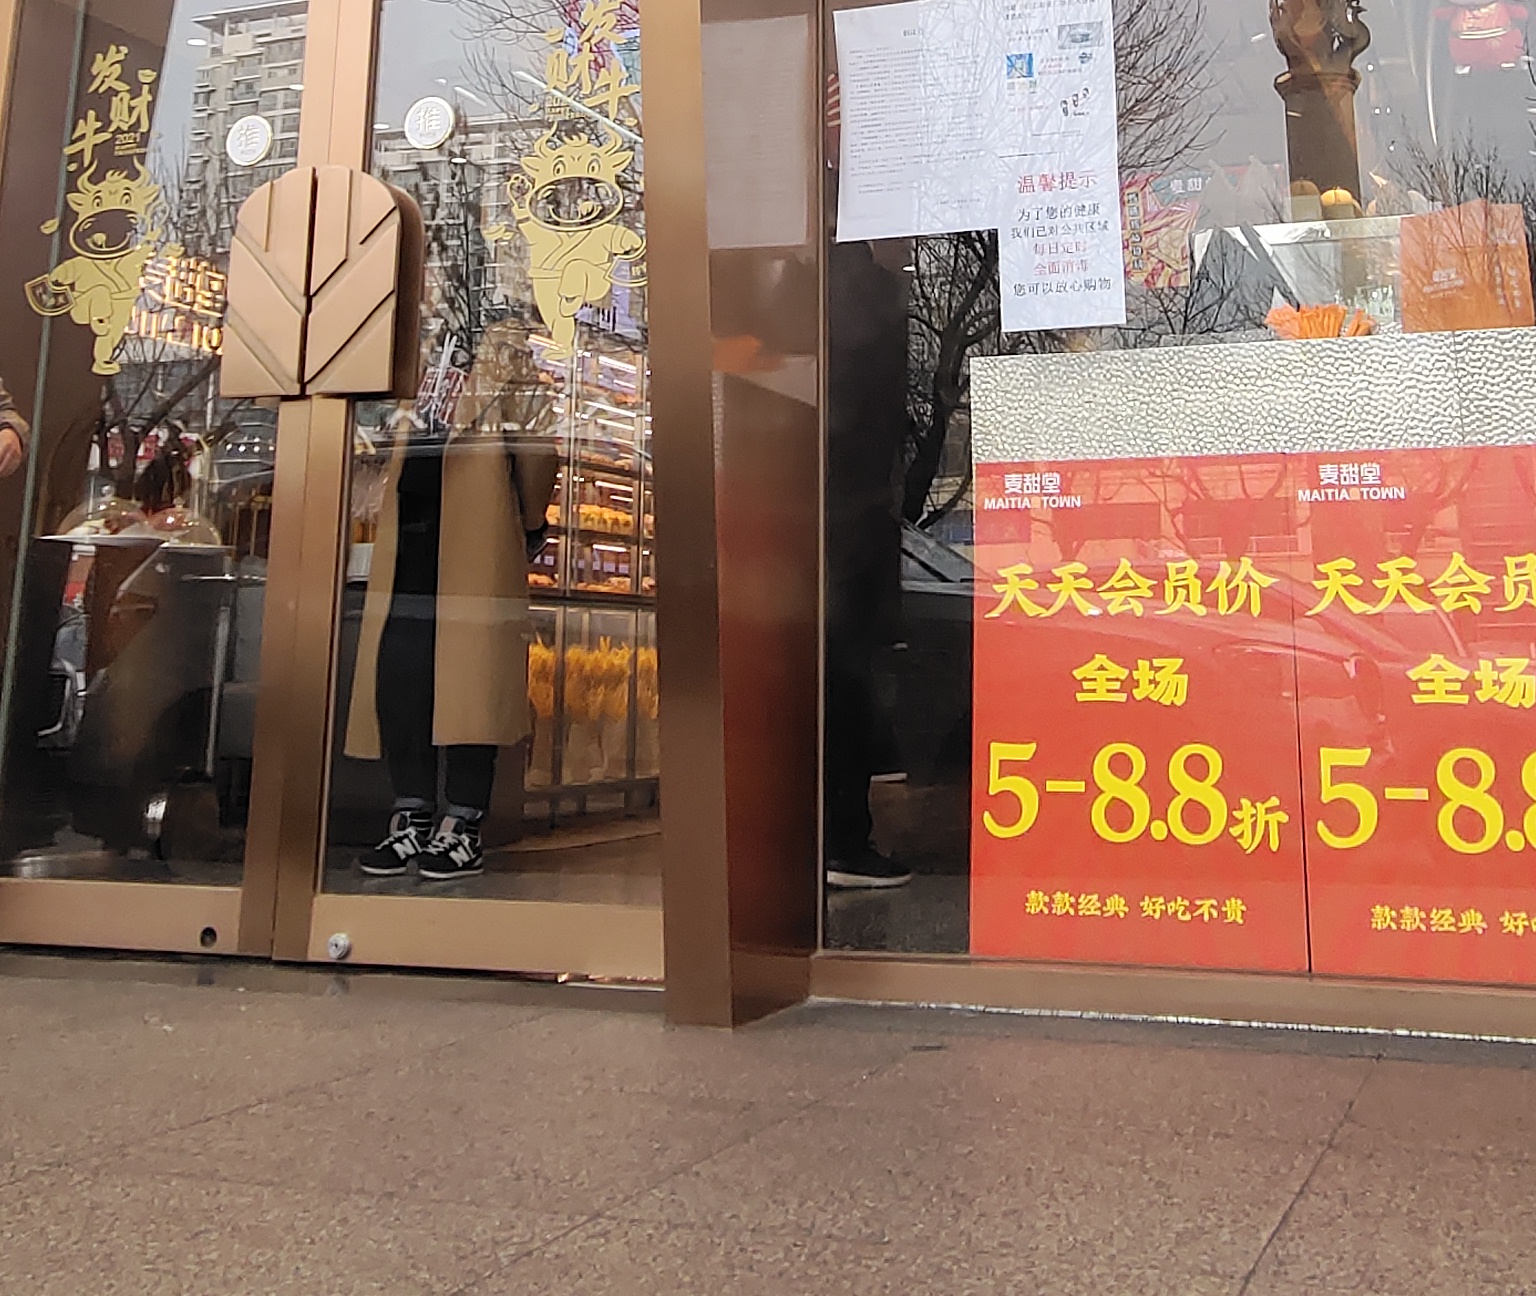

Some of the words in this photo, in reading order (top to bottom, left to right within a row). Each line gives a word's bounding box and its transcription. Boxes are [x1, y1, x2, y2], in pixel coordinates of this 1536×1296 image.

[414, 106, 441, 133] 推
[236, 123, 260, 149] 推
[1017, 171, 1098, 194] 温馨提示
[1017, 202, 1101, 222] 为了您的健康
[1033, 260, 1089, 277] 全面消毒
[1013, 278, 1111, 297] 您可以放心购物
[1004, 472, 1061, 495] 麦甜堂
[1319, 463, 1382, 486] 麦甜堂
[984, 496, 1032, 510] MAITIA
[1041, 495, 1081, 508] TOWN
[1298, 488, 1350, 502] MAITIA
[1360, 486, 1405, 501] TOWN
[985, 557, 1279, 618] 天天会员价
[1071, 654, 1188, 706] 全场
[982, 741, 1289, 855] 5-8.8折
[1025, 889, 1129, 920] 款款经典
[1140, 895, 1247, 925] 好吃不贵
[1370, 904, 1488, 935] 款款经典
